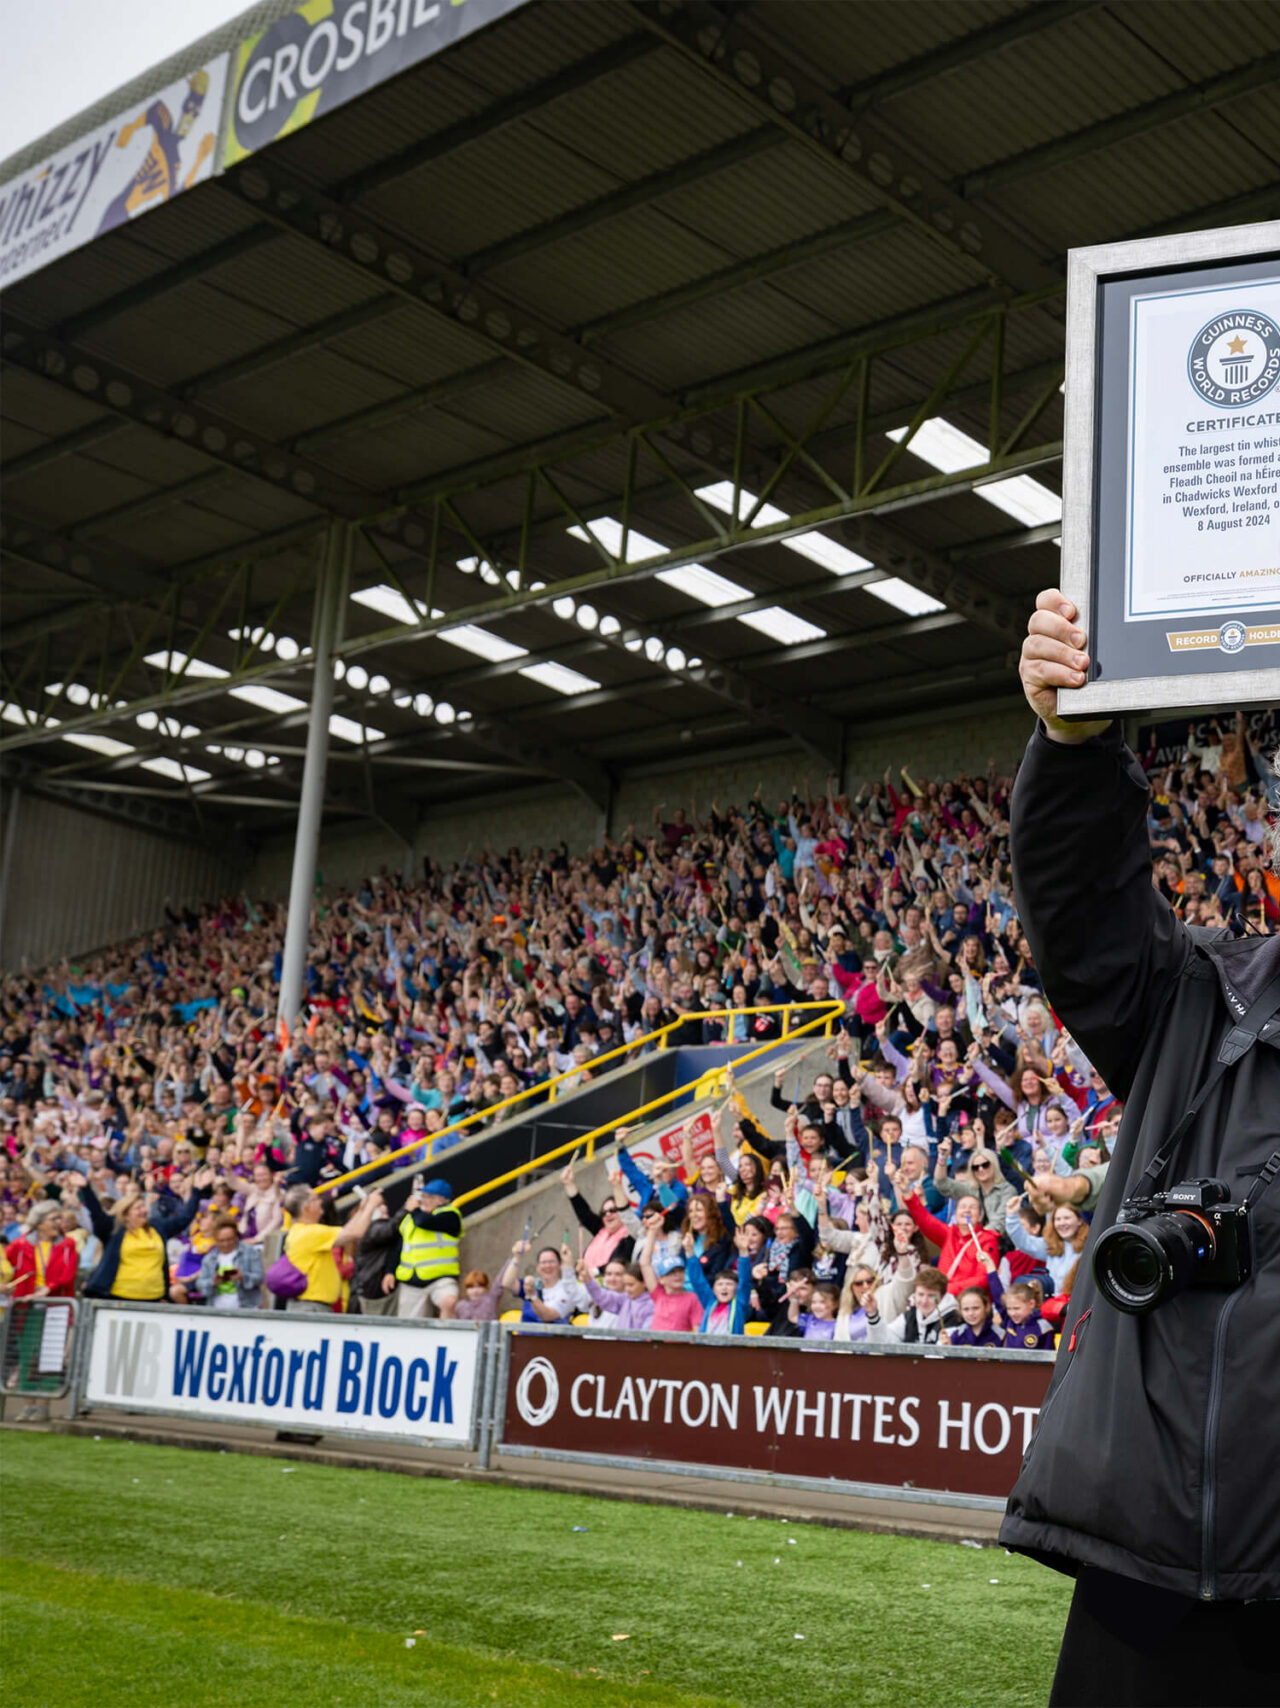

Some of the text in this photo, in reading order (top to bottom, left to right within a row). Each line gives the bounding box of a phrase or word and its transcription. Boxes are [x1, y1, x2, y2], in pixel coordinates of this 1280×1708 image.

[1202, 315, 1273, 345] GUINNESS
[1193, 348, 1280, 402] WORLD RECORDS
[1179, 445, 1197, 457] The
[1200, 442, 1235, 455] largest
[1238, 440, 1251, 450] tin
[1163, 459, 1211, 473] ensemble
[1214, 458, 1235, 468] was
[1239, 452, 1275, 466] formed
[1170, 476, 1202, 488] Fleadh
[1206, 471, 1237, 485] Cheoil
[1240, 471, 1252, 481] na
[1163, 493, 1172, 504] in
[1175, 489, 1231, 503] Chadwicks
[1233, 483, 1277, 497] Wexford
[1182, 503, 1229, 517] Wexford,
[1232, 499, 1270, 513] Ireland,
[1198, 514, 1270, 532] 8 August 2024
[1183, 571, 1237, 583] OFFICIALLY
[1176, 634, 1217, 646] RECORD
[104, 1319, 163, 1399] WB
[172, 1328, 330, 1411] Wexford
[336, 1339, 459, 1424] Block
[570, 1372, 1041, 1456] CLAYTON WHITES HOT
